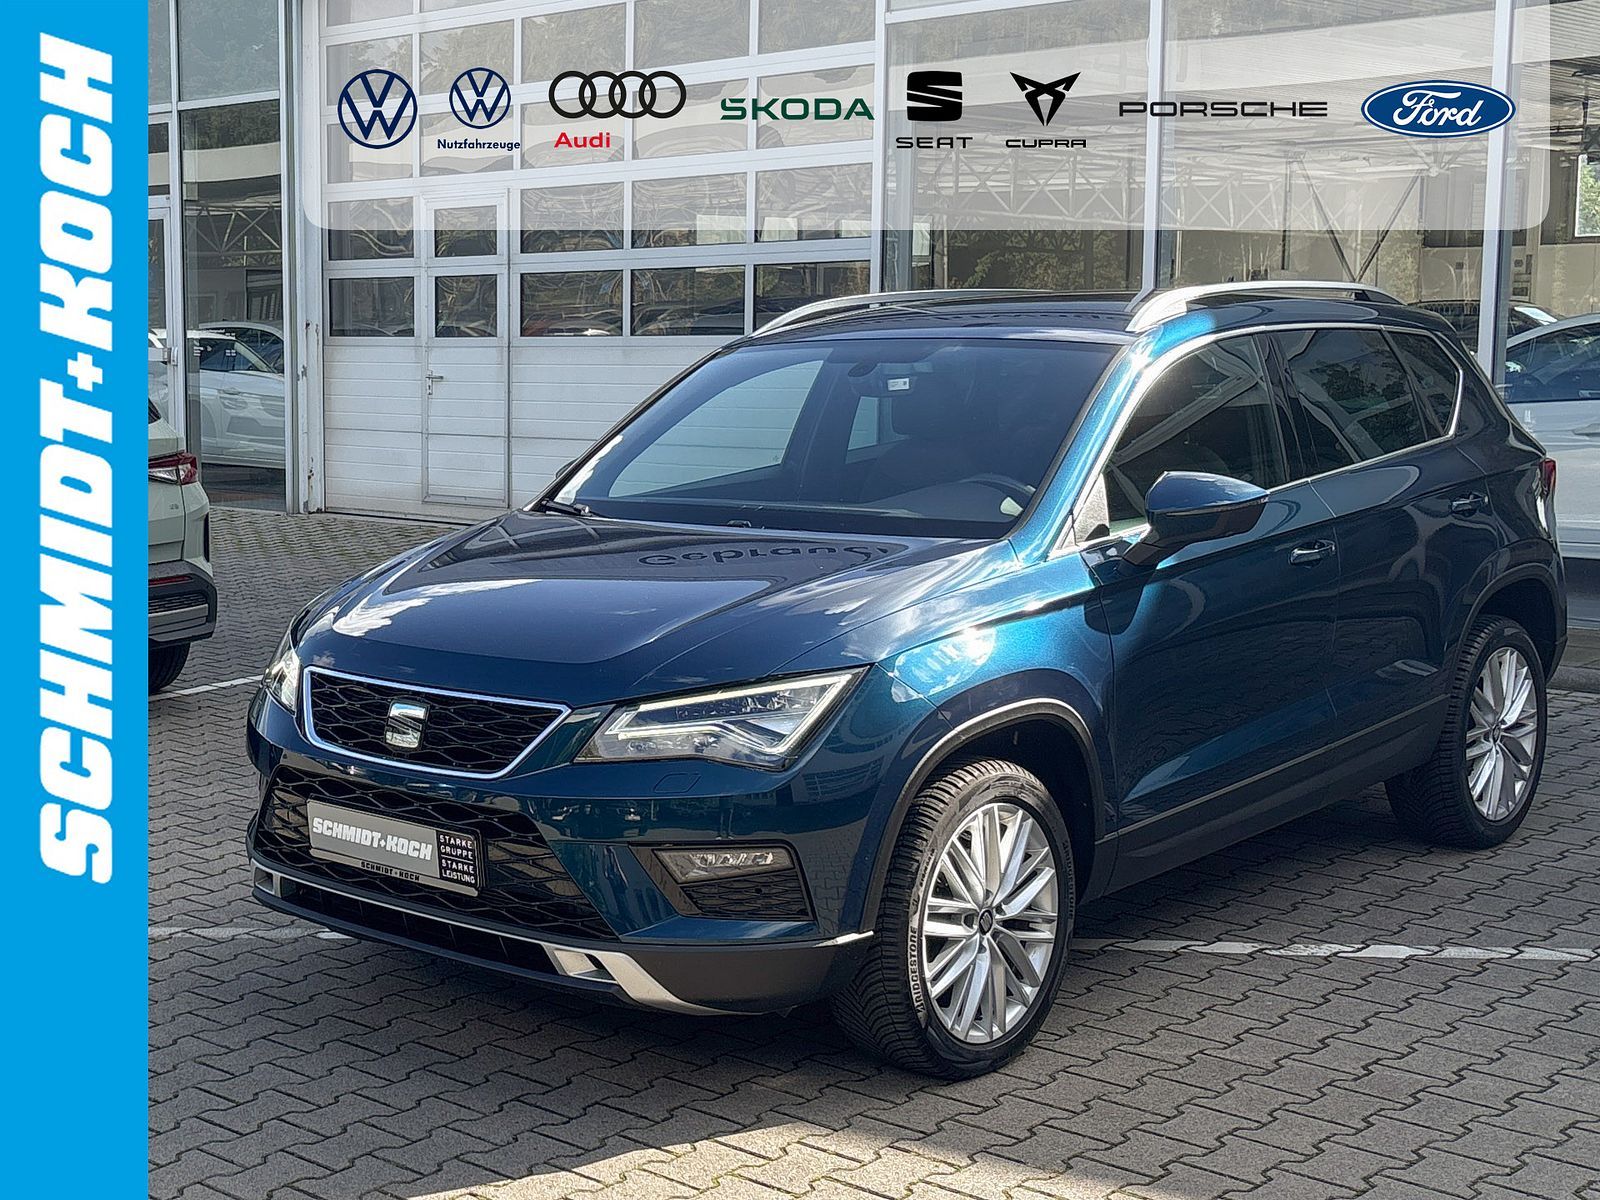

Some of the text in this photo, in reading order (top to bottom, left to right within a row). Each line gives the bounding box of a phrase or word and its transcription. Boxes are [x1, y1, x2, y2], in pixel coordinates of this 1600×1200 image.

[312, 817, 433, 860] SCHMIDT+KOCH
[439, 834, 473, 849] STARKE
[440, 845, 474, 860] GRUPPE
[441, 859, 475, 874] STARKE
[442, 869, 476, 884] LEISTUNG
